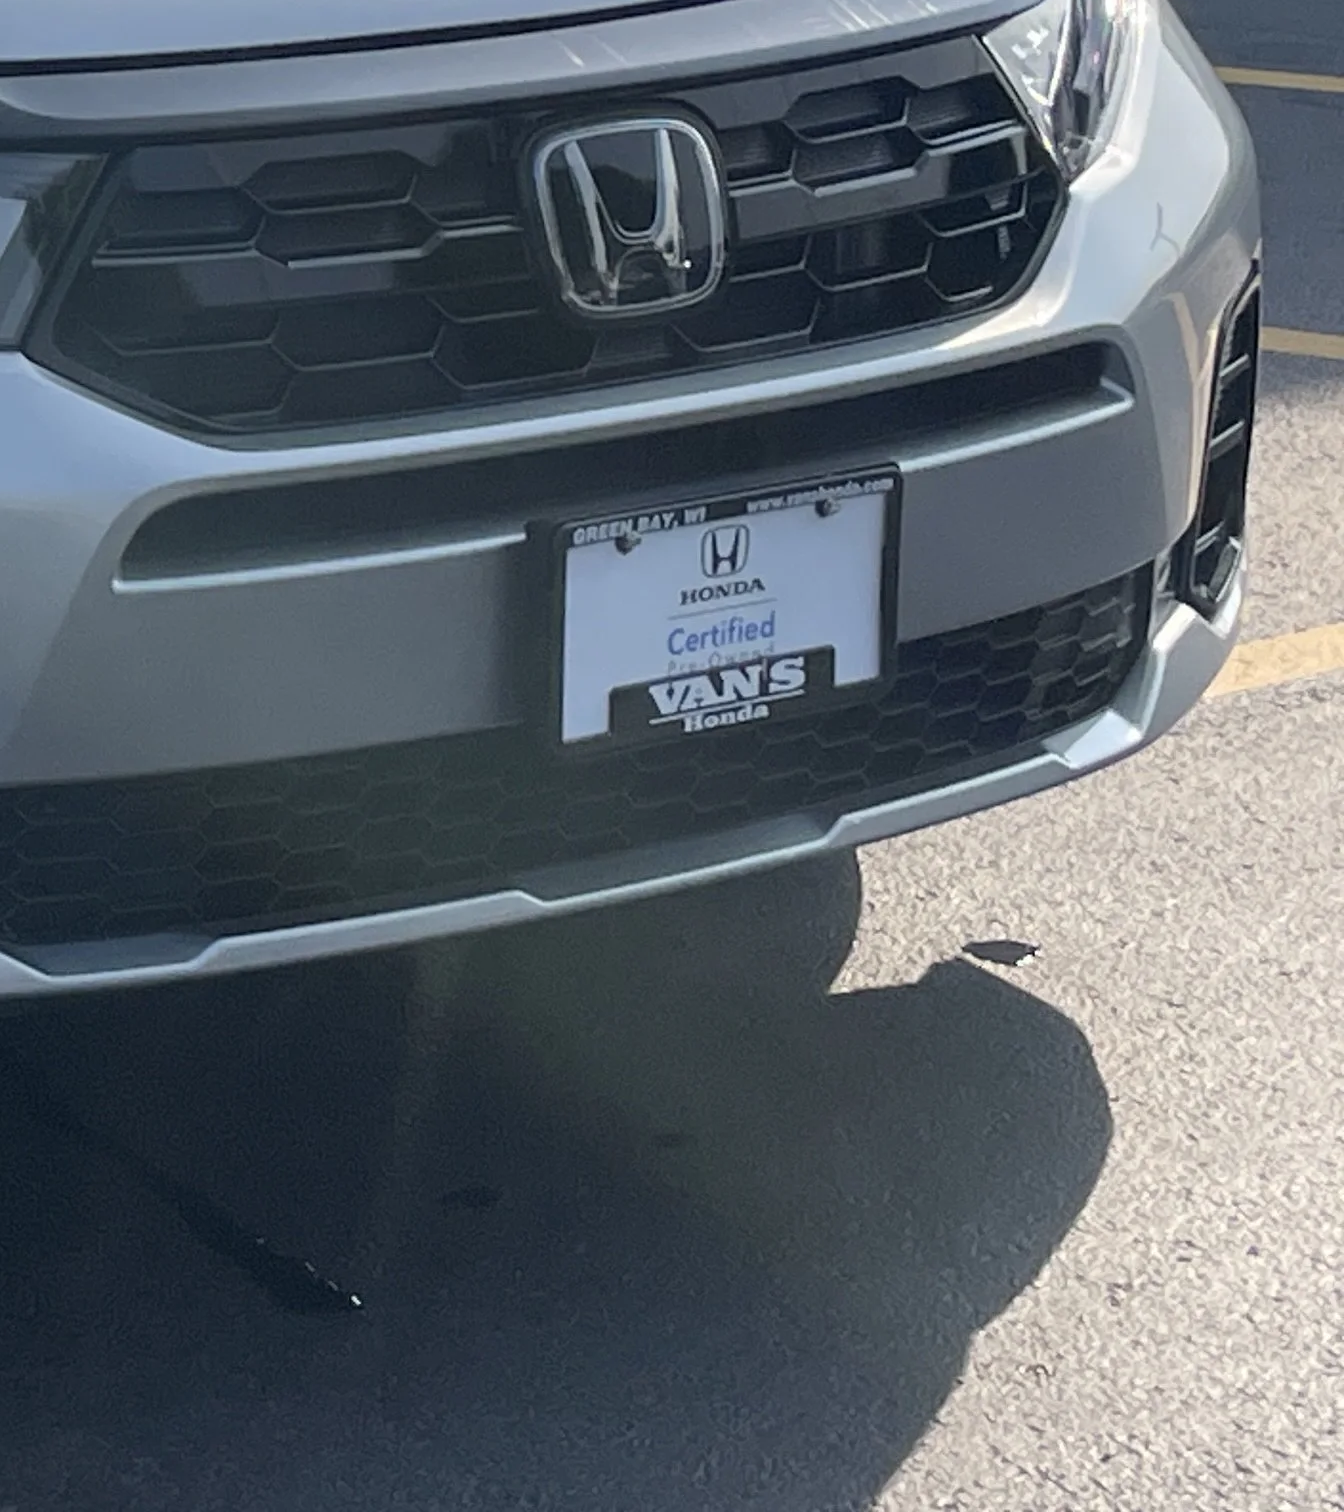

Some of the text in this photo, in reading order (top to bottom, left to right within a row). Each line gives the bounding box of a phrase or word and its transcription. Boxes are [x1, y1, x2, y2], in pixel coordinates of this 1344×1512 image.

[573, 519, 633, 545] GREEN
[683, 506, 708, 524] WI
[679, 577, 766, 606] HONDA
[667, 609, 776, 656] Certified
[683, 703, 771, 733] Honda
